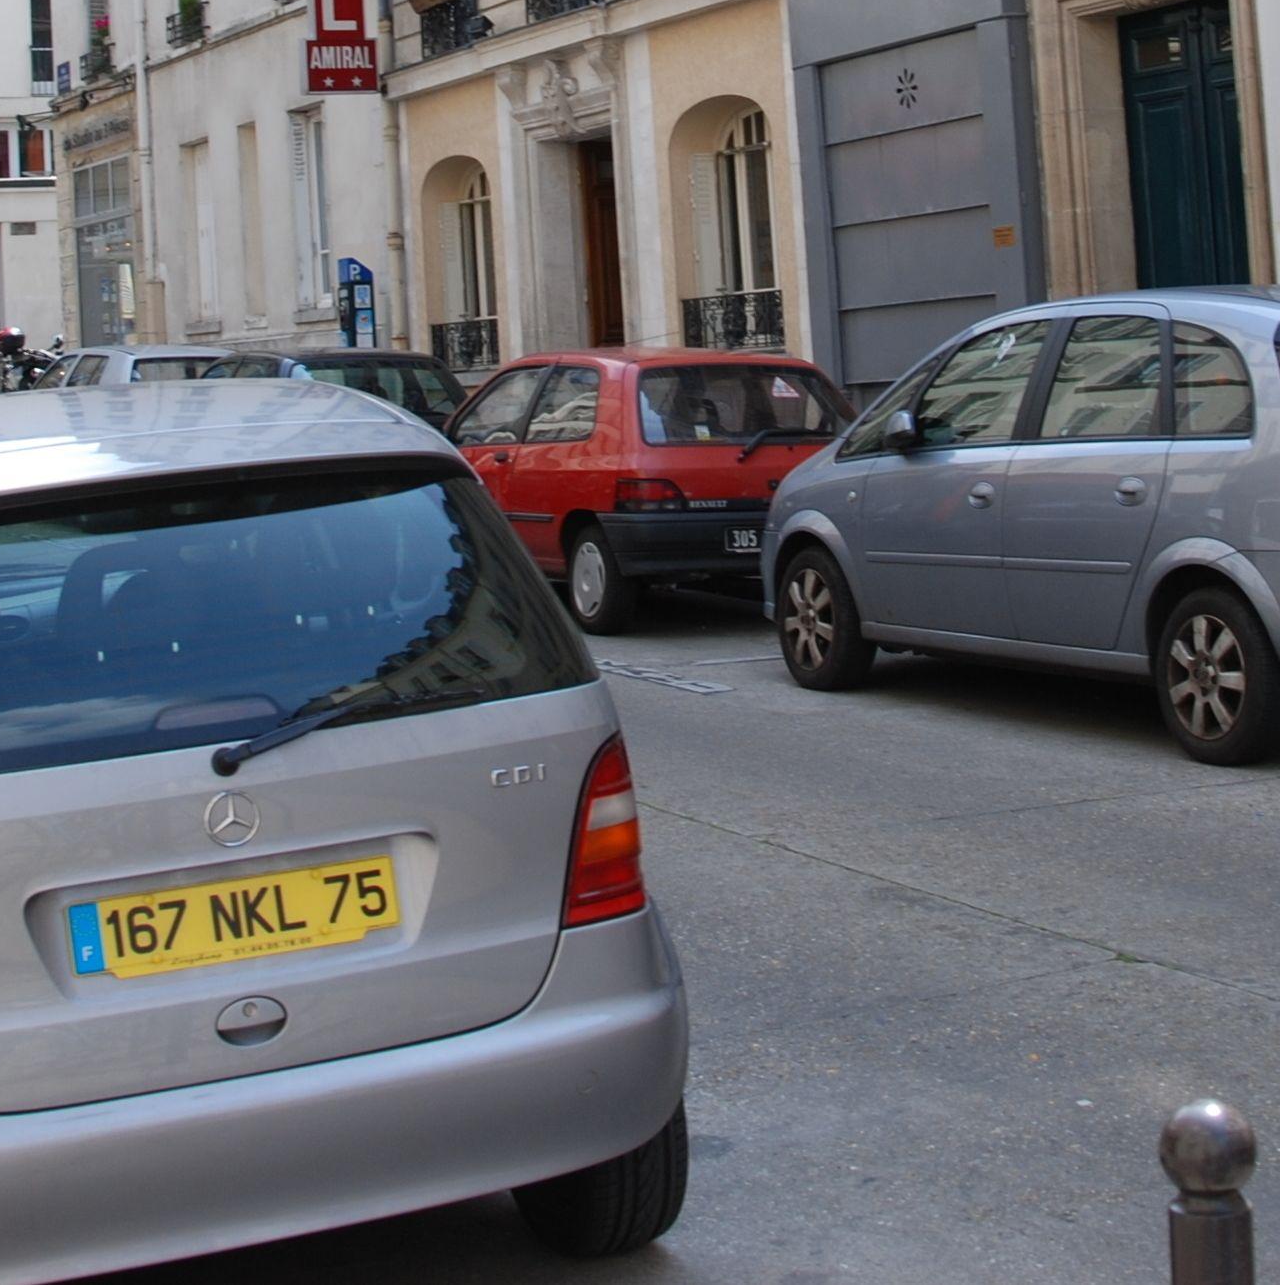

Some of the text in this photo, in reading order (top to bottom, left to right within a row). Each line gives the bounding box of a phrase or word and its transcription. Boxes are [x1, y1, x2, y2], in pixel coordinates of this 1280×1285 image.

[310, 46, 374, 69] AMIRAL
[349, 264, 361, 281] P
[732, 530, 758, 547] 305
[491, 763, 545, 787] CDI
[106, 869, 388, 958] 167 NKL 75
[82, 946, 94, 962] F
